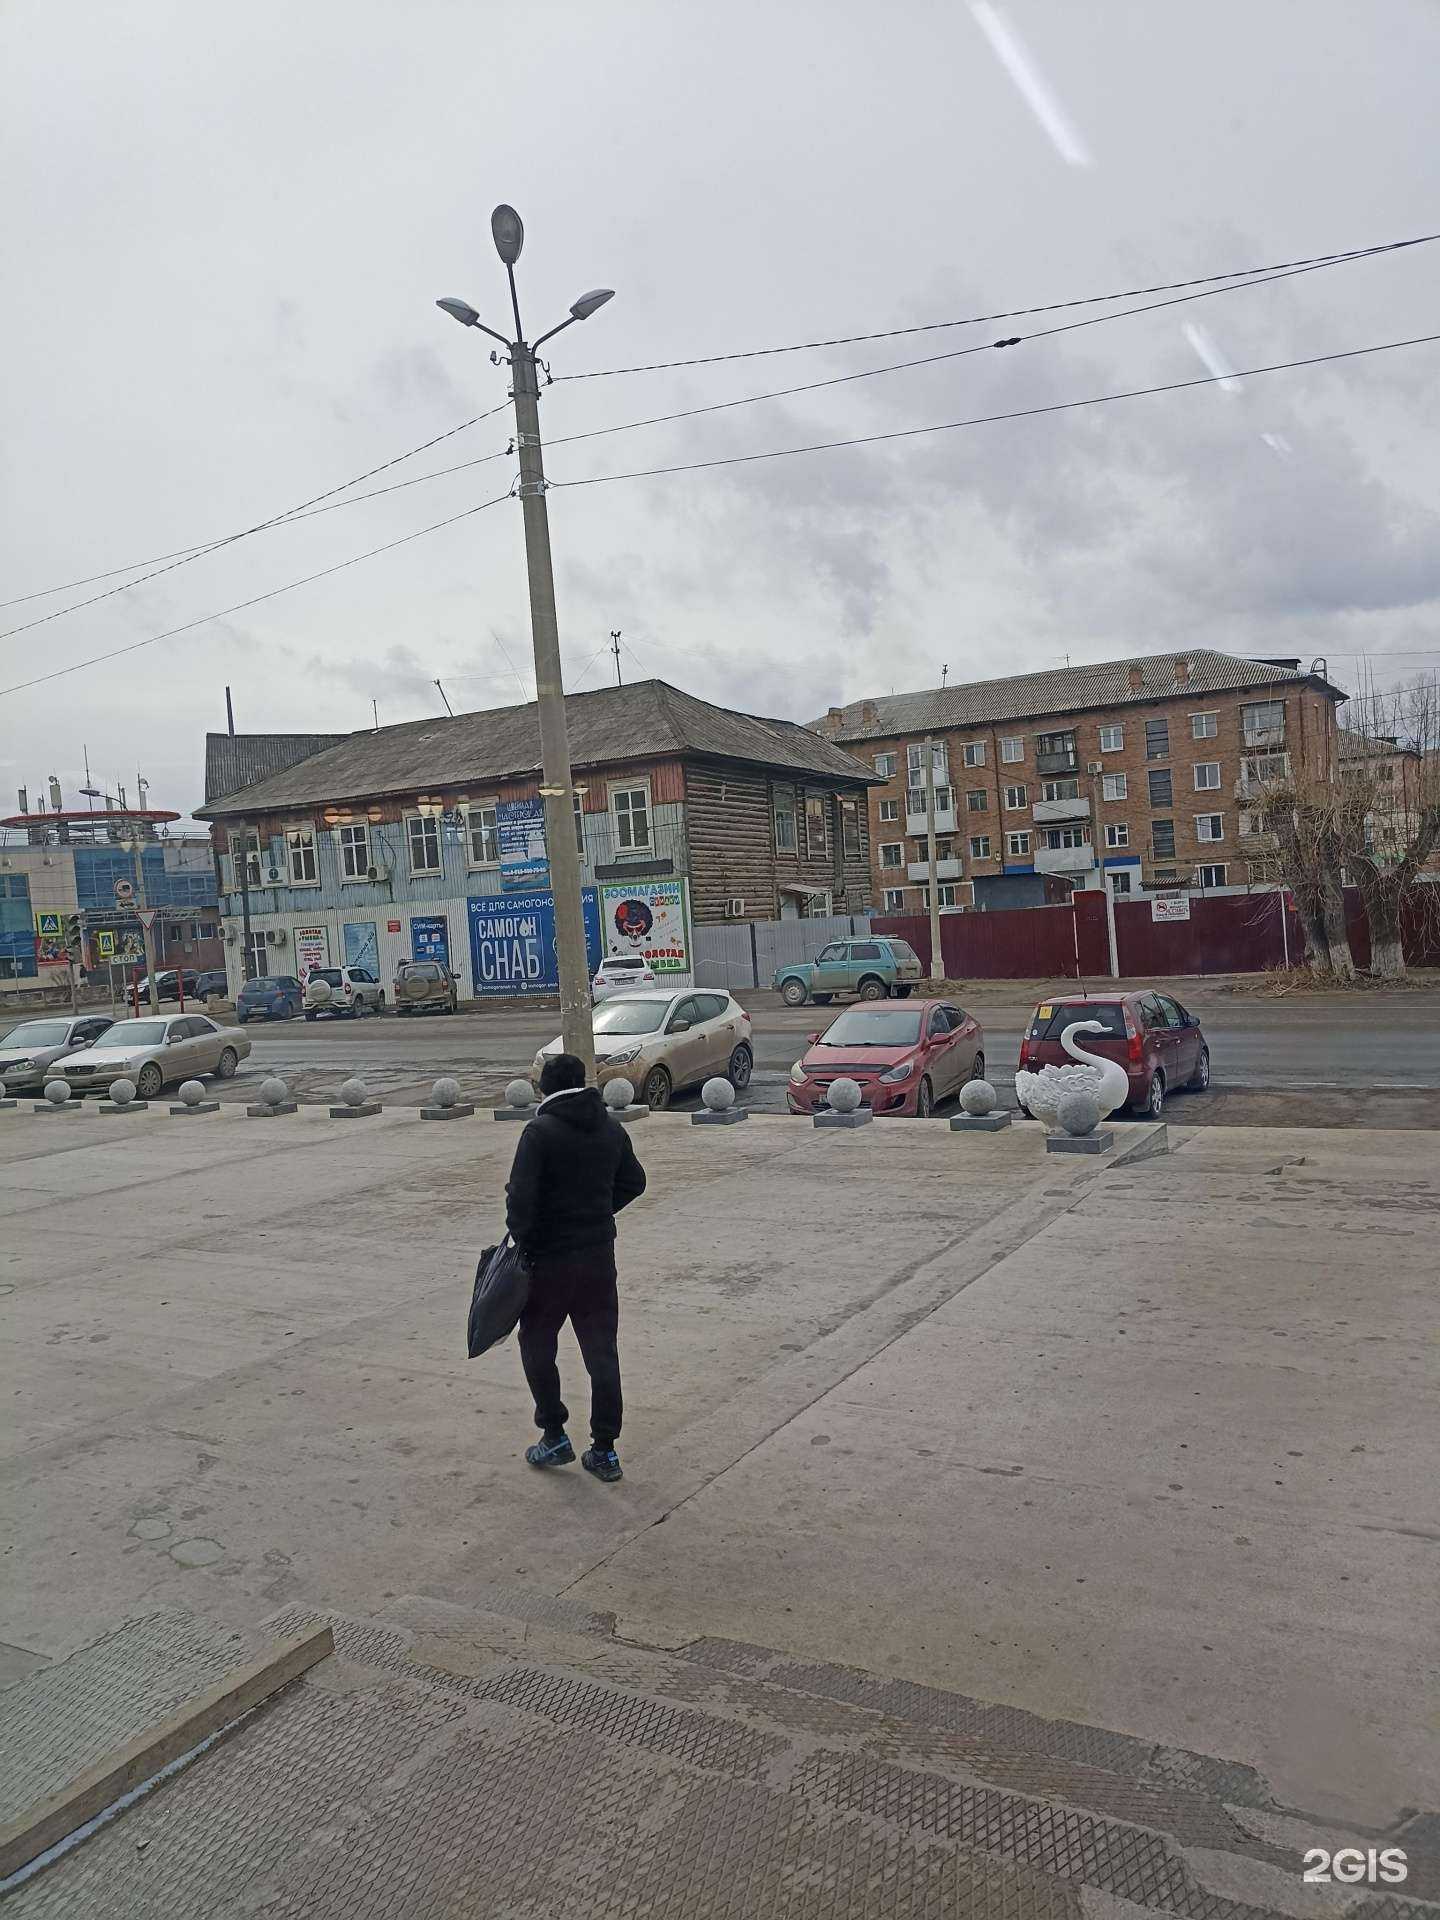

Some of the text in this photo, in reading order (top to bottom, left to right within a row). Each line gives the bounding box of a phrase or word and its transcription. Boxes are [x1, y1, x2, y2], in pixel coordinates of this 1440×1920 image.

[604, 883, 680, 899] ЗООМАГАЗИН
[470, 903, 486, 912] ВСЕ
[488, 902, 505, 912] ДЛЯ
[113, 955, 135, 963] СТОП
[481, 939, 541, 980] СНАБ
